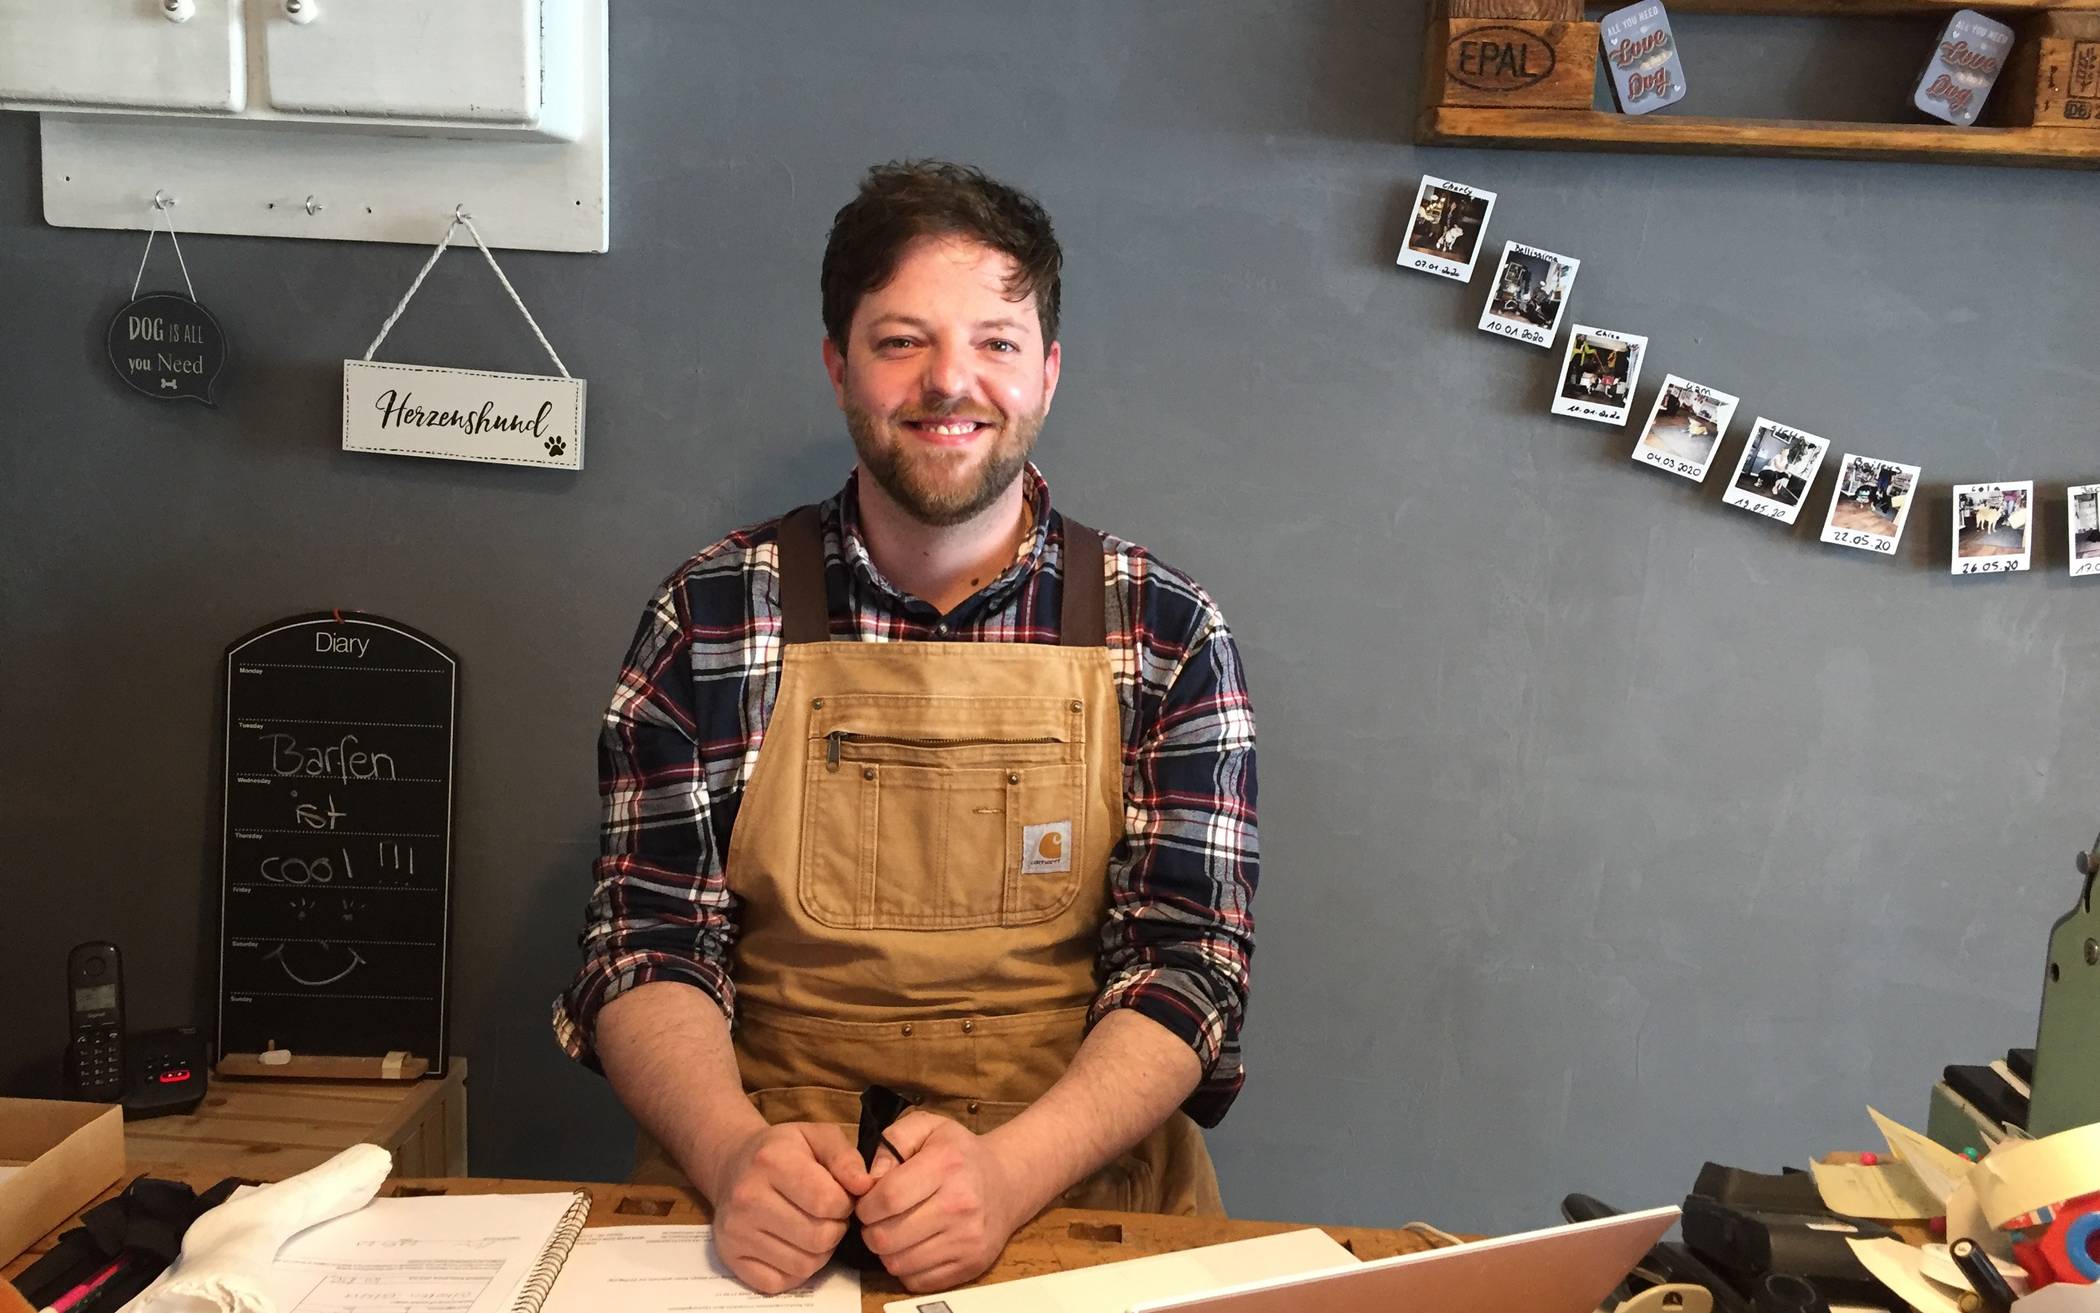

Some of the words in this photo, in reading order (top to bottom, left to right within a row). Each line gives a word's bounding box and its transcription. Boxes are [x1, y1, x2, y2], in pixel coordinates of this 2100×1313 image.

[1607, 23, 1621, 37] ALL
[1622, 15, 1638, 29] YOU
[1638, 6, 1658, 20] NEED
[1459, 41, 1538, 78] EPAL
[1609, 29, 1667, 69] Love
[1941, 40, 1997, 74] Love
[1628, 67, 1669, 101] Dog
[1925, 74, 1972, 113] Dog
[1442, 181, 1473, 196] Charly
[128, 316, 164, 341] DOG
[169, 323, 180, 343] IS
[184, 323, 204, 344] ALL
[128, 358, 152, 375] you
[158, 352, 203, 374] Need
[375, 389, 553, 438] Herzenshund
[1833, 531, 1891, 551] 22.05.20
[315, 632, 371, 658] Diary
[239, 667, 263, 675] Monday
[238, 722, 264, 730] Tuesday
[259, 733, 397, 785] Barfen
[236, 777, 271, 785] Wednesday
[290, 790, 347, 830] ist
[234, 832, 263, 840] Thursday
[261, 847, 353, 884] cool
[232, 886, 252, 894] Friday
[231, 941, 260, 949] Saturday
